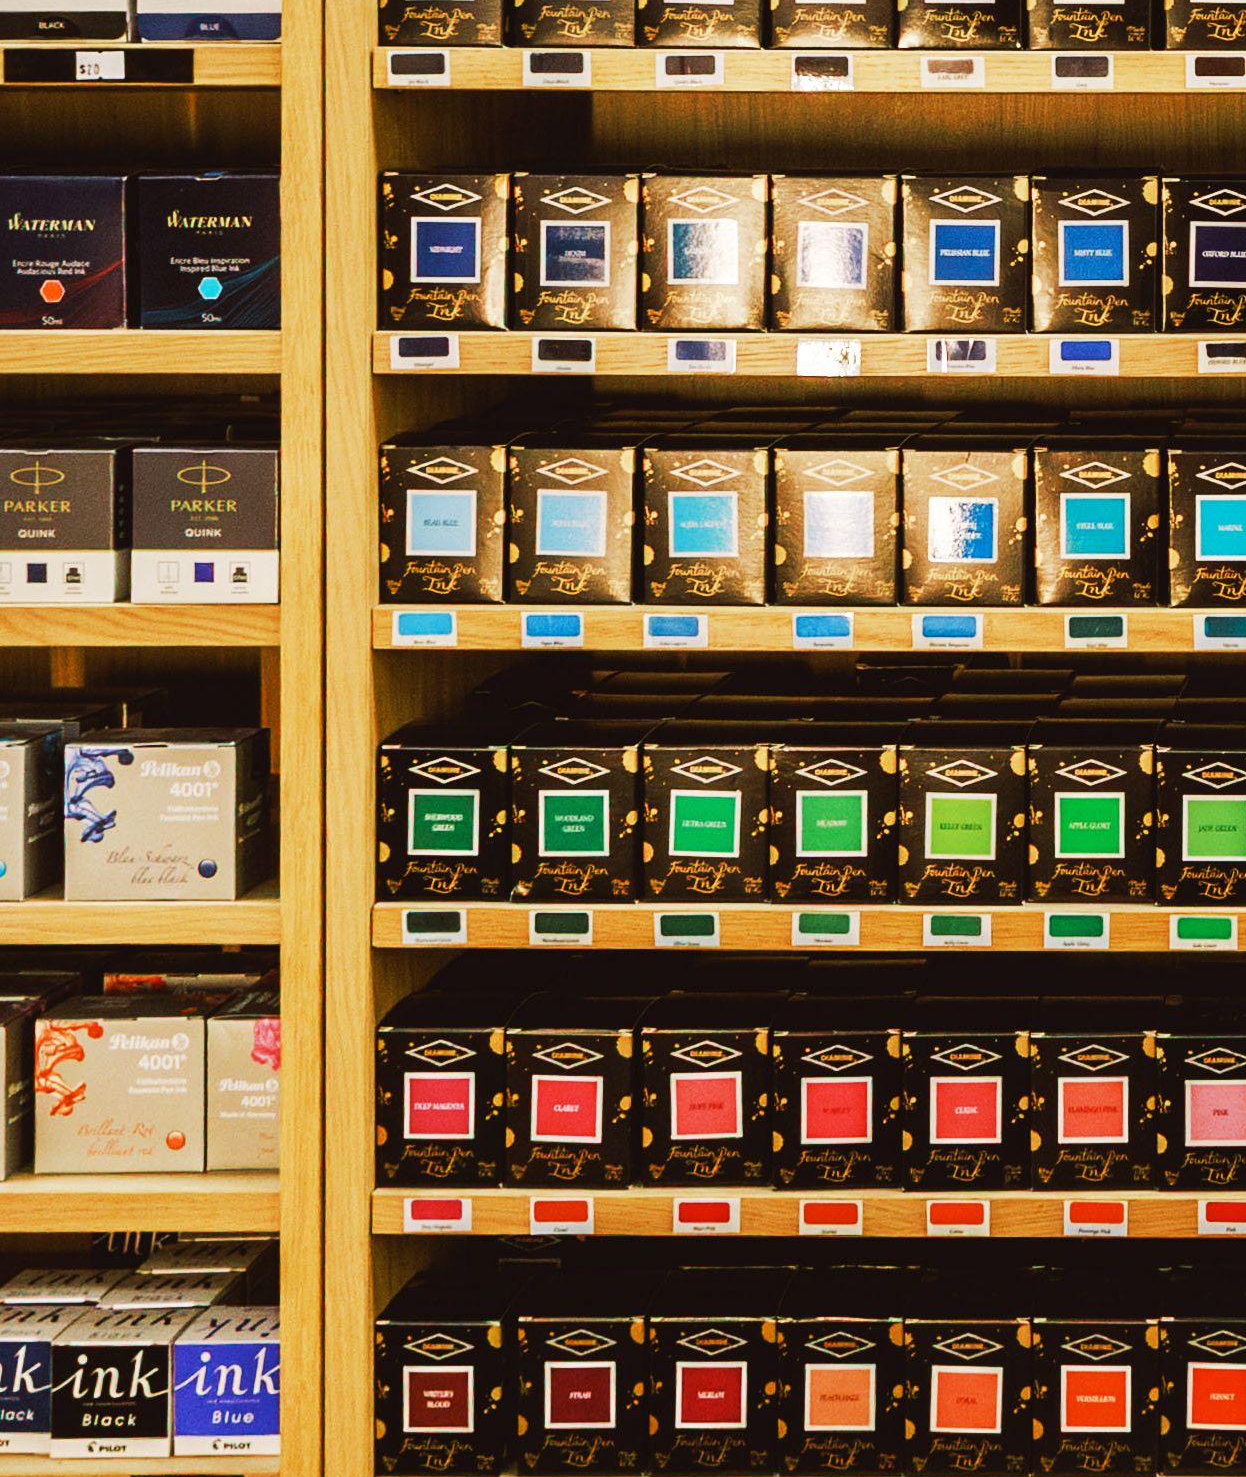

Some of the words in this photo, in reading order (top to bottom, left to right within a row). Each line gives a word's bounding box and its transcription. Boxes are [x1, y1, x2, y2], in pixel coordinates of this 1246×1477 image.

[200, 23, 220, 31] BLUE
[7, 214, 96, 234] WATERMAN
[166, 211, 252, 231] WATERMAN
[170, 257, 191, 265] Encre
[193, 257, 207, 265] Bleu
[209, 257, 250, 266] Inspiration
[179, 265, 210, 273] Inspired
[211, 265, 225, 273] Blue
[227, 265, 239, 273] Ink
[4, 499, 71, 514] PARKER
[171, 499, 237, 513] PARKER
[18, 529, 56, 539] QUINK
[185, 527, 222, 538] QUINK
[139, 760, 201, 780] Pelikan
[108, 1033, 170, 1052] Pelikan
[52, 1349, 168, 1399] ink
[81, 1412, 137, 1429] Black
[212, 1409, 255, 1425] Blue
[100, 1442, 127, 1452] PILOT
[223, 1440, 252, 1450] PILOT
